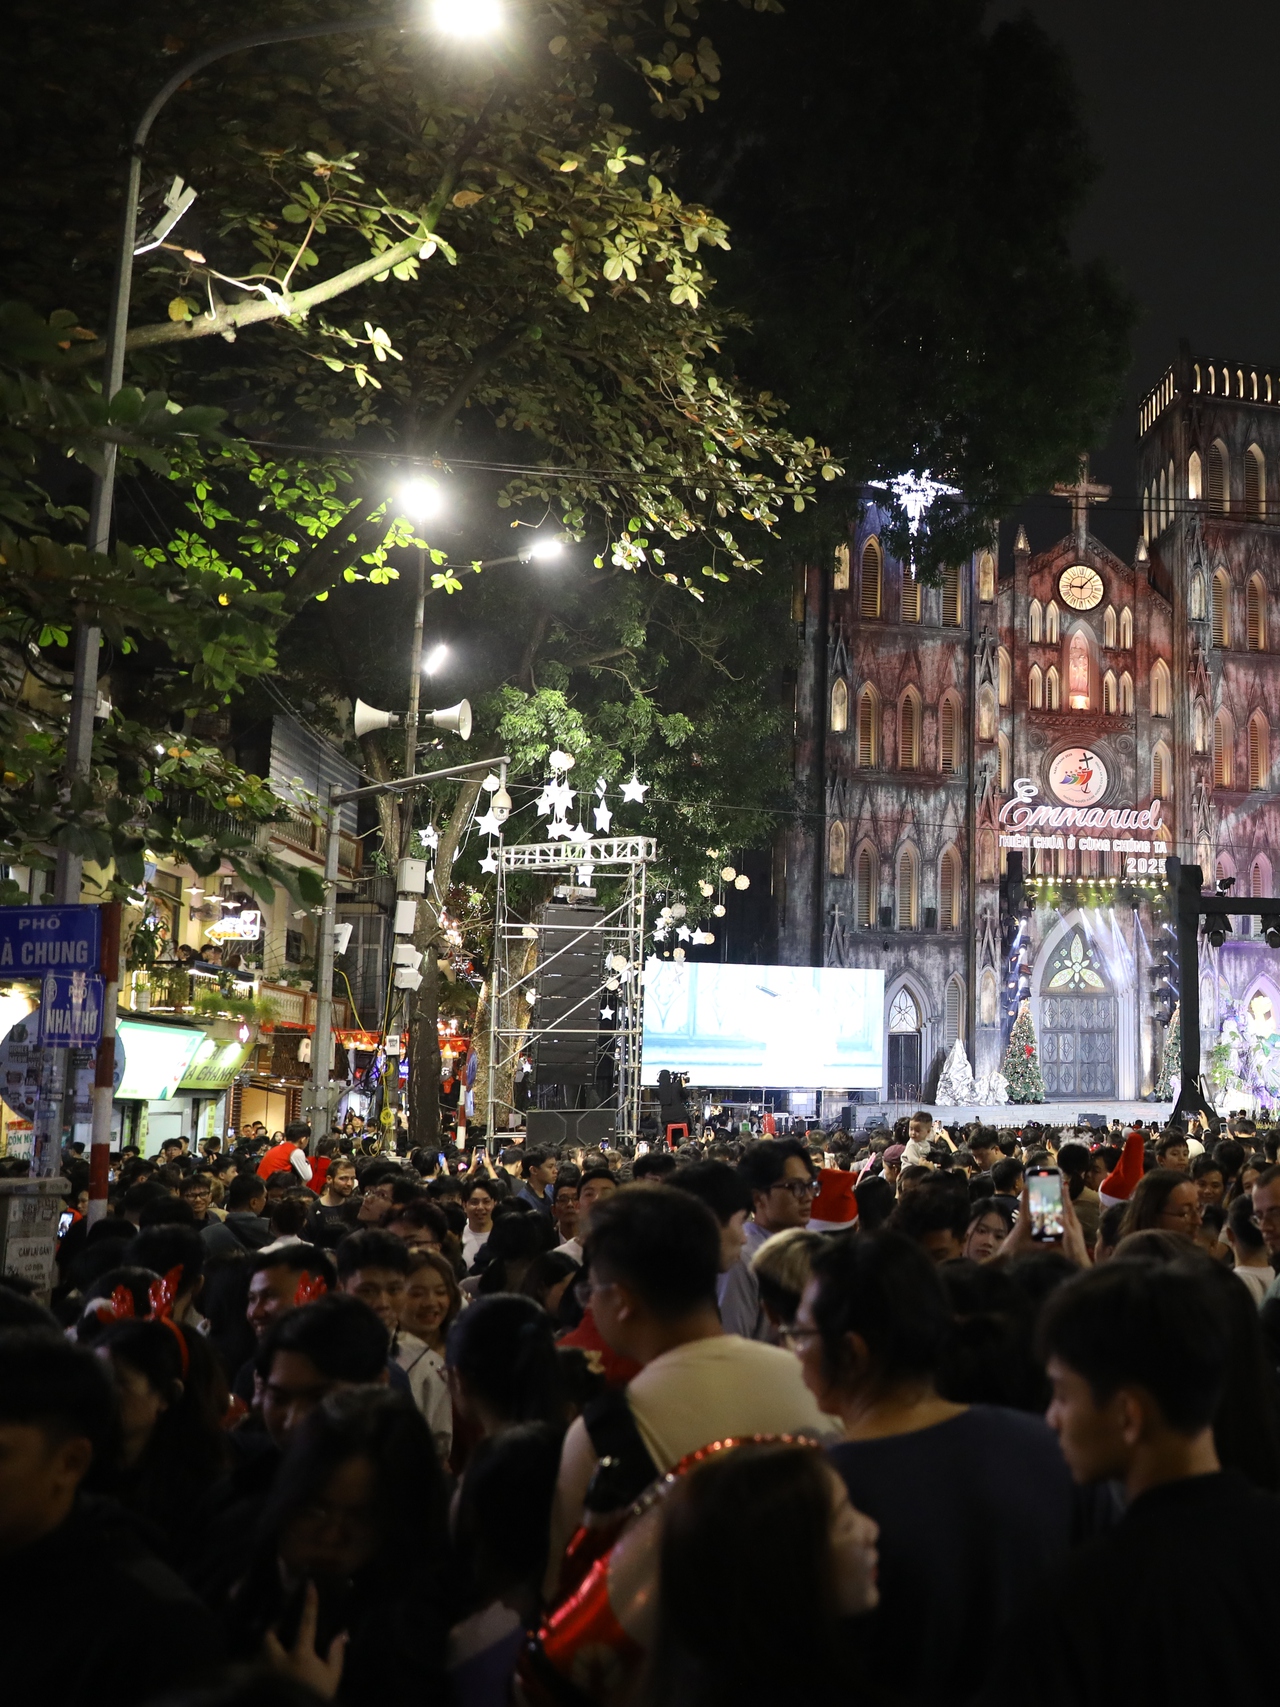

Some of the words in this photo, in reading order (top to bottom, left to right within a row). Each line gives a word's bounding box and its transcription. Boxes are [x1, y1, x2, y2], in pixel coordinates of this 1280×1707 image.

[999, 778, 1162, 832] Emmanuel
[999, 833, 1030, 848] THIÊN
[1033, 834, 1065, 850] CHÚA
[1078, 836, 1111, 852] CÙNG
[1113, 837, 1151, 853] CHÚNG
[1153, 841, 1168, 854] TA
[1126, 857, 1167, 874] 2025
[19, 912, 62, 930] PHỐ
[21, 940, 89, 966] CHUNG
[46, 1003, 72, 1035] NHÀ
